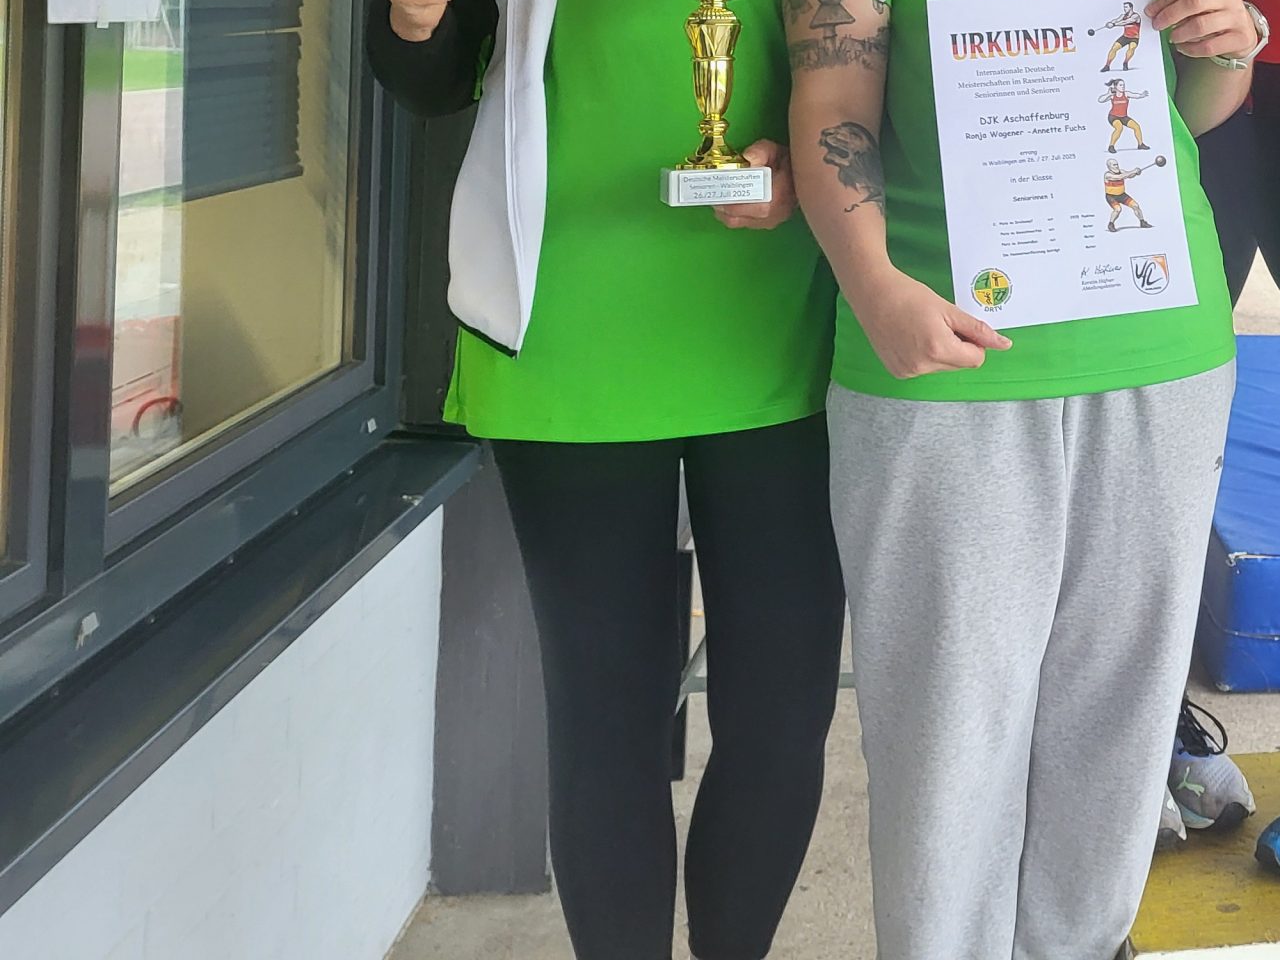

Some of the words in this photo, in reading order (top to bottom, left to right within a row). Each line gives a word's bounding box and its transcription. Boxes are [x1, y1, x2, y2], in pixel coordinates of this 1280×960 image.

[950, 26, 1077, 61] URKUNDE
[976, 67, 1023, 76] Internationale
[1025, 65, 1055, 73] Deutsche
[958, 79, 1010, 89] Meisterschaften
[1023, 75, 1074, 84] Rasenkraftsport
[975, 90, 1015, 99] Seniorinnen
[980, 116, 999, 125] DJK
[1003, 112, 1070, 123] Aschaffenburg
[965, 132, 987, 140] Ronja
[990, 130, 1024, 139] Wagener
[1028, 126, 1062, 134] -Annette
[1065, 124, 1086, 132] Fuchs
